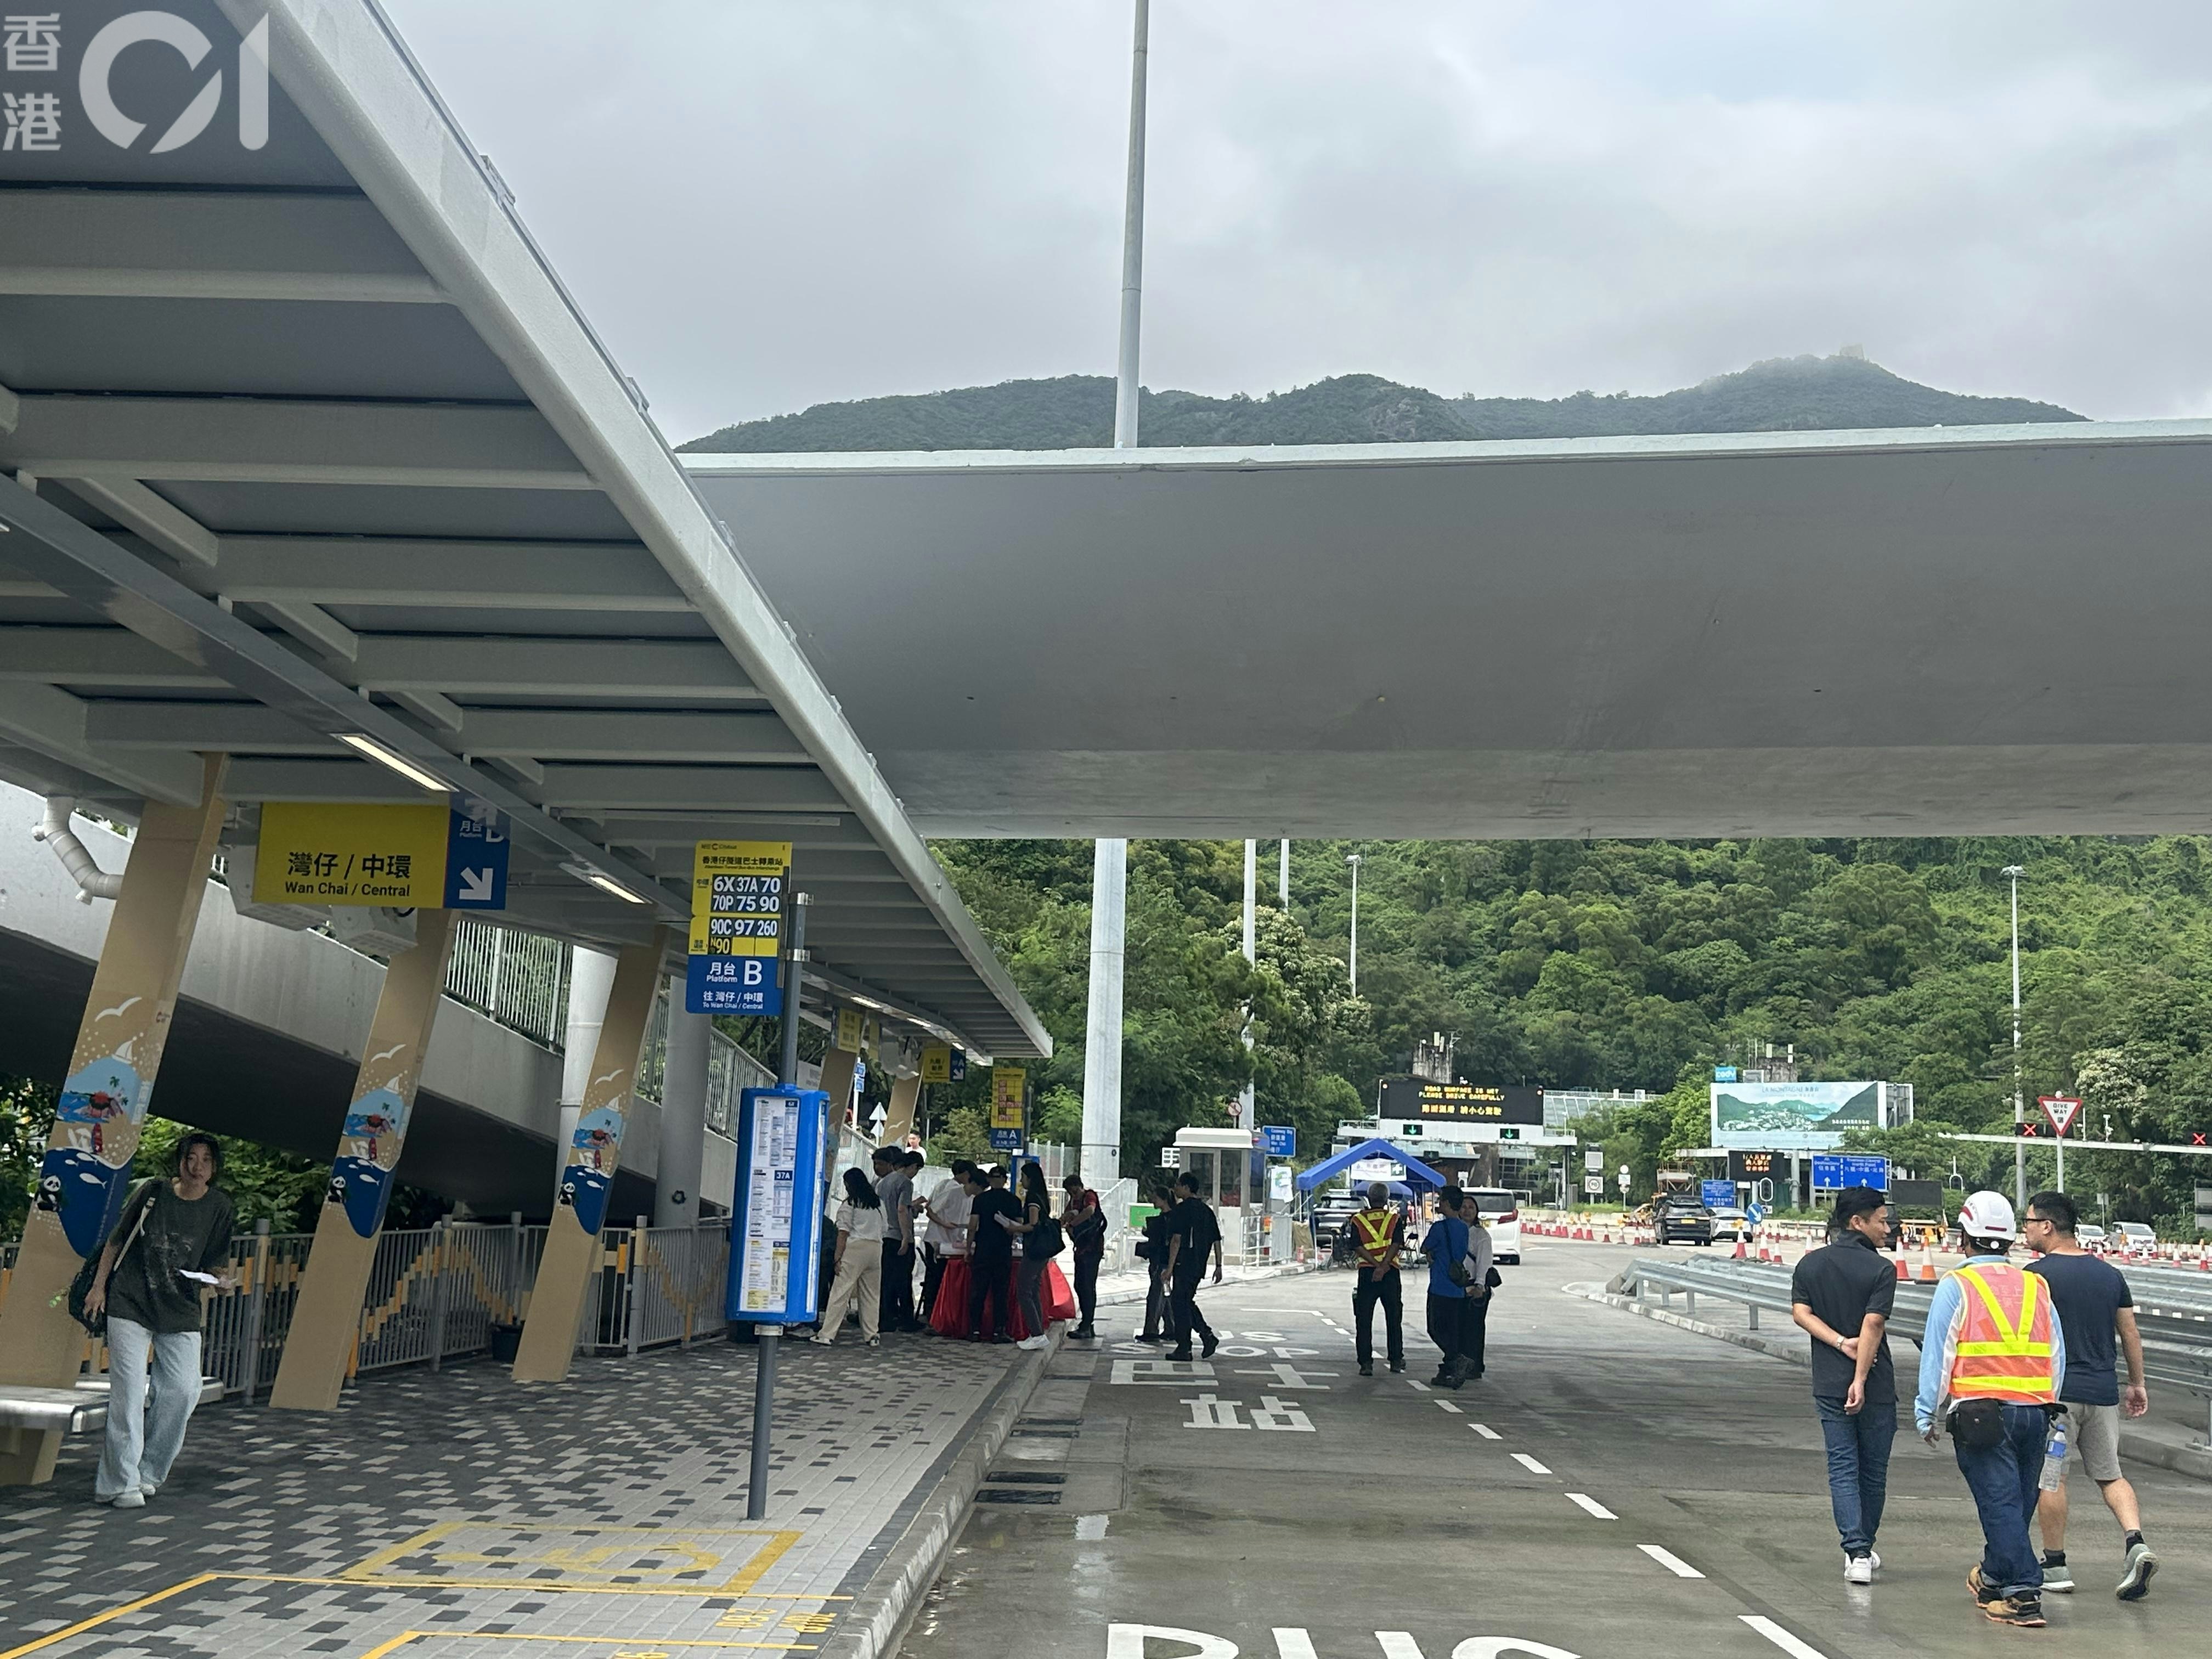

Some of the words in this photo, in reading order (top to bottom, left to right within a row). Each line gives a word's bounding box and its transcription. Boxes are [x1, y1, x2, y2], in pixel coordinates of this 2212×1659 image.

[288, 852, 338, 878] 灣仔
[361, 854, 411, 879] 中環
[285, 881, 314, 895] Wan
[318, 882, 348, 896] Chai
[361, 884, 410, 898] Central
[714, 876, 735, 893] 6X
[736, 877, 759, 893] 37A
[760, 878, 781, 894] 70
[713, 894, 735, 911] 70P
[737, 895, 757, 912] 75
[759, 895, 780, 913] 90
[710, 918, 732, 935] 90C
[734, 919, 755, 936] 97
[756, 920, 778, 936] 260
[709, 962, 736, 975] 月台
[743, 960, 763, 985] B
[706, 974, 737, 983] Platform
[703, 990, 713, 1002] 往
[715, 991, 736, 1002] 灣仔
[743, 991, 763, 1003] 中環
[958, 1058, 964, 1067] A
[1009, 1130, 1017, 1139] A
[1110, 1359, 1340, 1390] 巴士
[1180, 1393, 1317, 1432] 站
